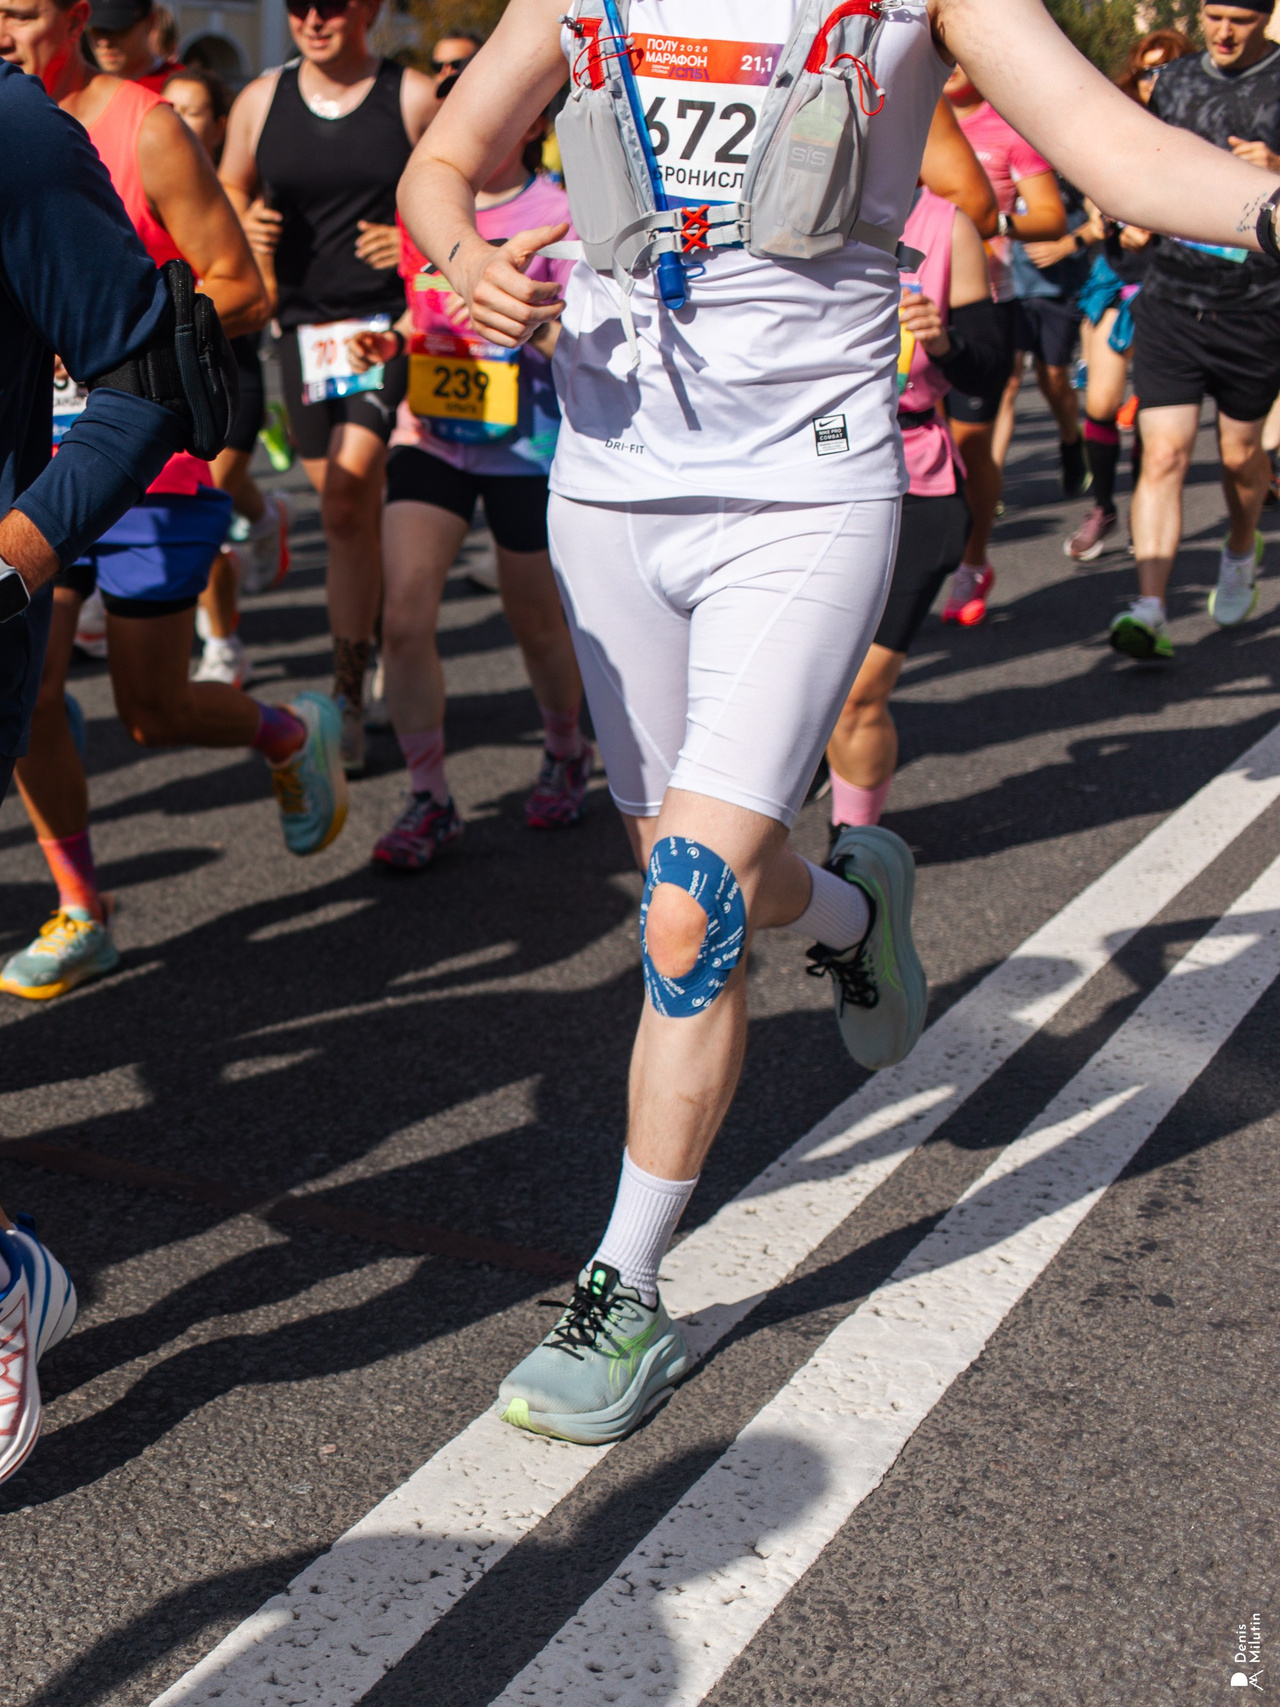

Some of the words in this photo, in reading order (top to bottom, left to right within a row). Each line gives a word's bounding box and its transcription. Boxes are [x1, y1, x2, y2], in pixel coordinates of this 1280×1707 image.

[647, 38, 679, 52] ПОЛУ
[679, 44, 708, 53] 2026
[645, 51, 708, 67] МАРАФОН
[740, 55, 773, 74] 21,1
[644, 96, 756, 164] 672
[433, 366, 489, 402] 239
[820, 433, 843, 441] COMBAT
[605, 439, 645, 454] DRI-FIT
